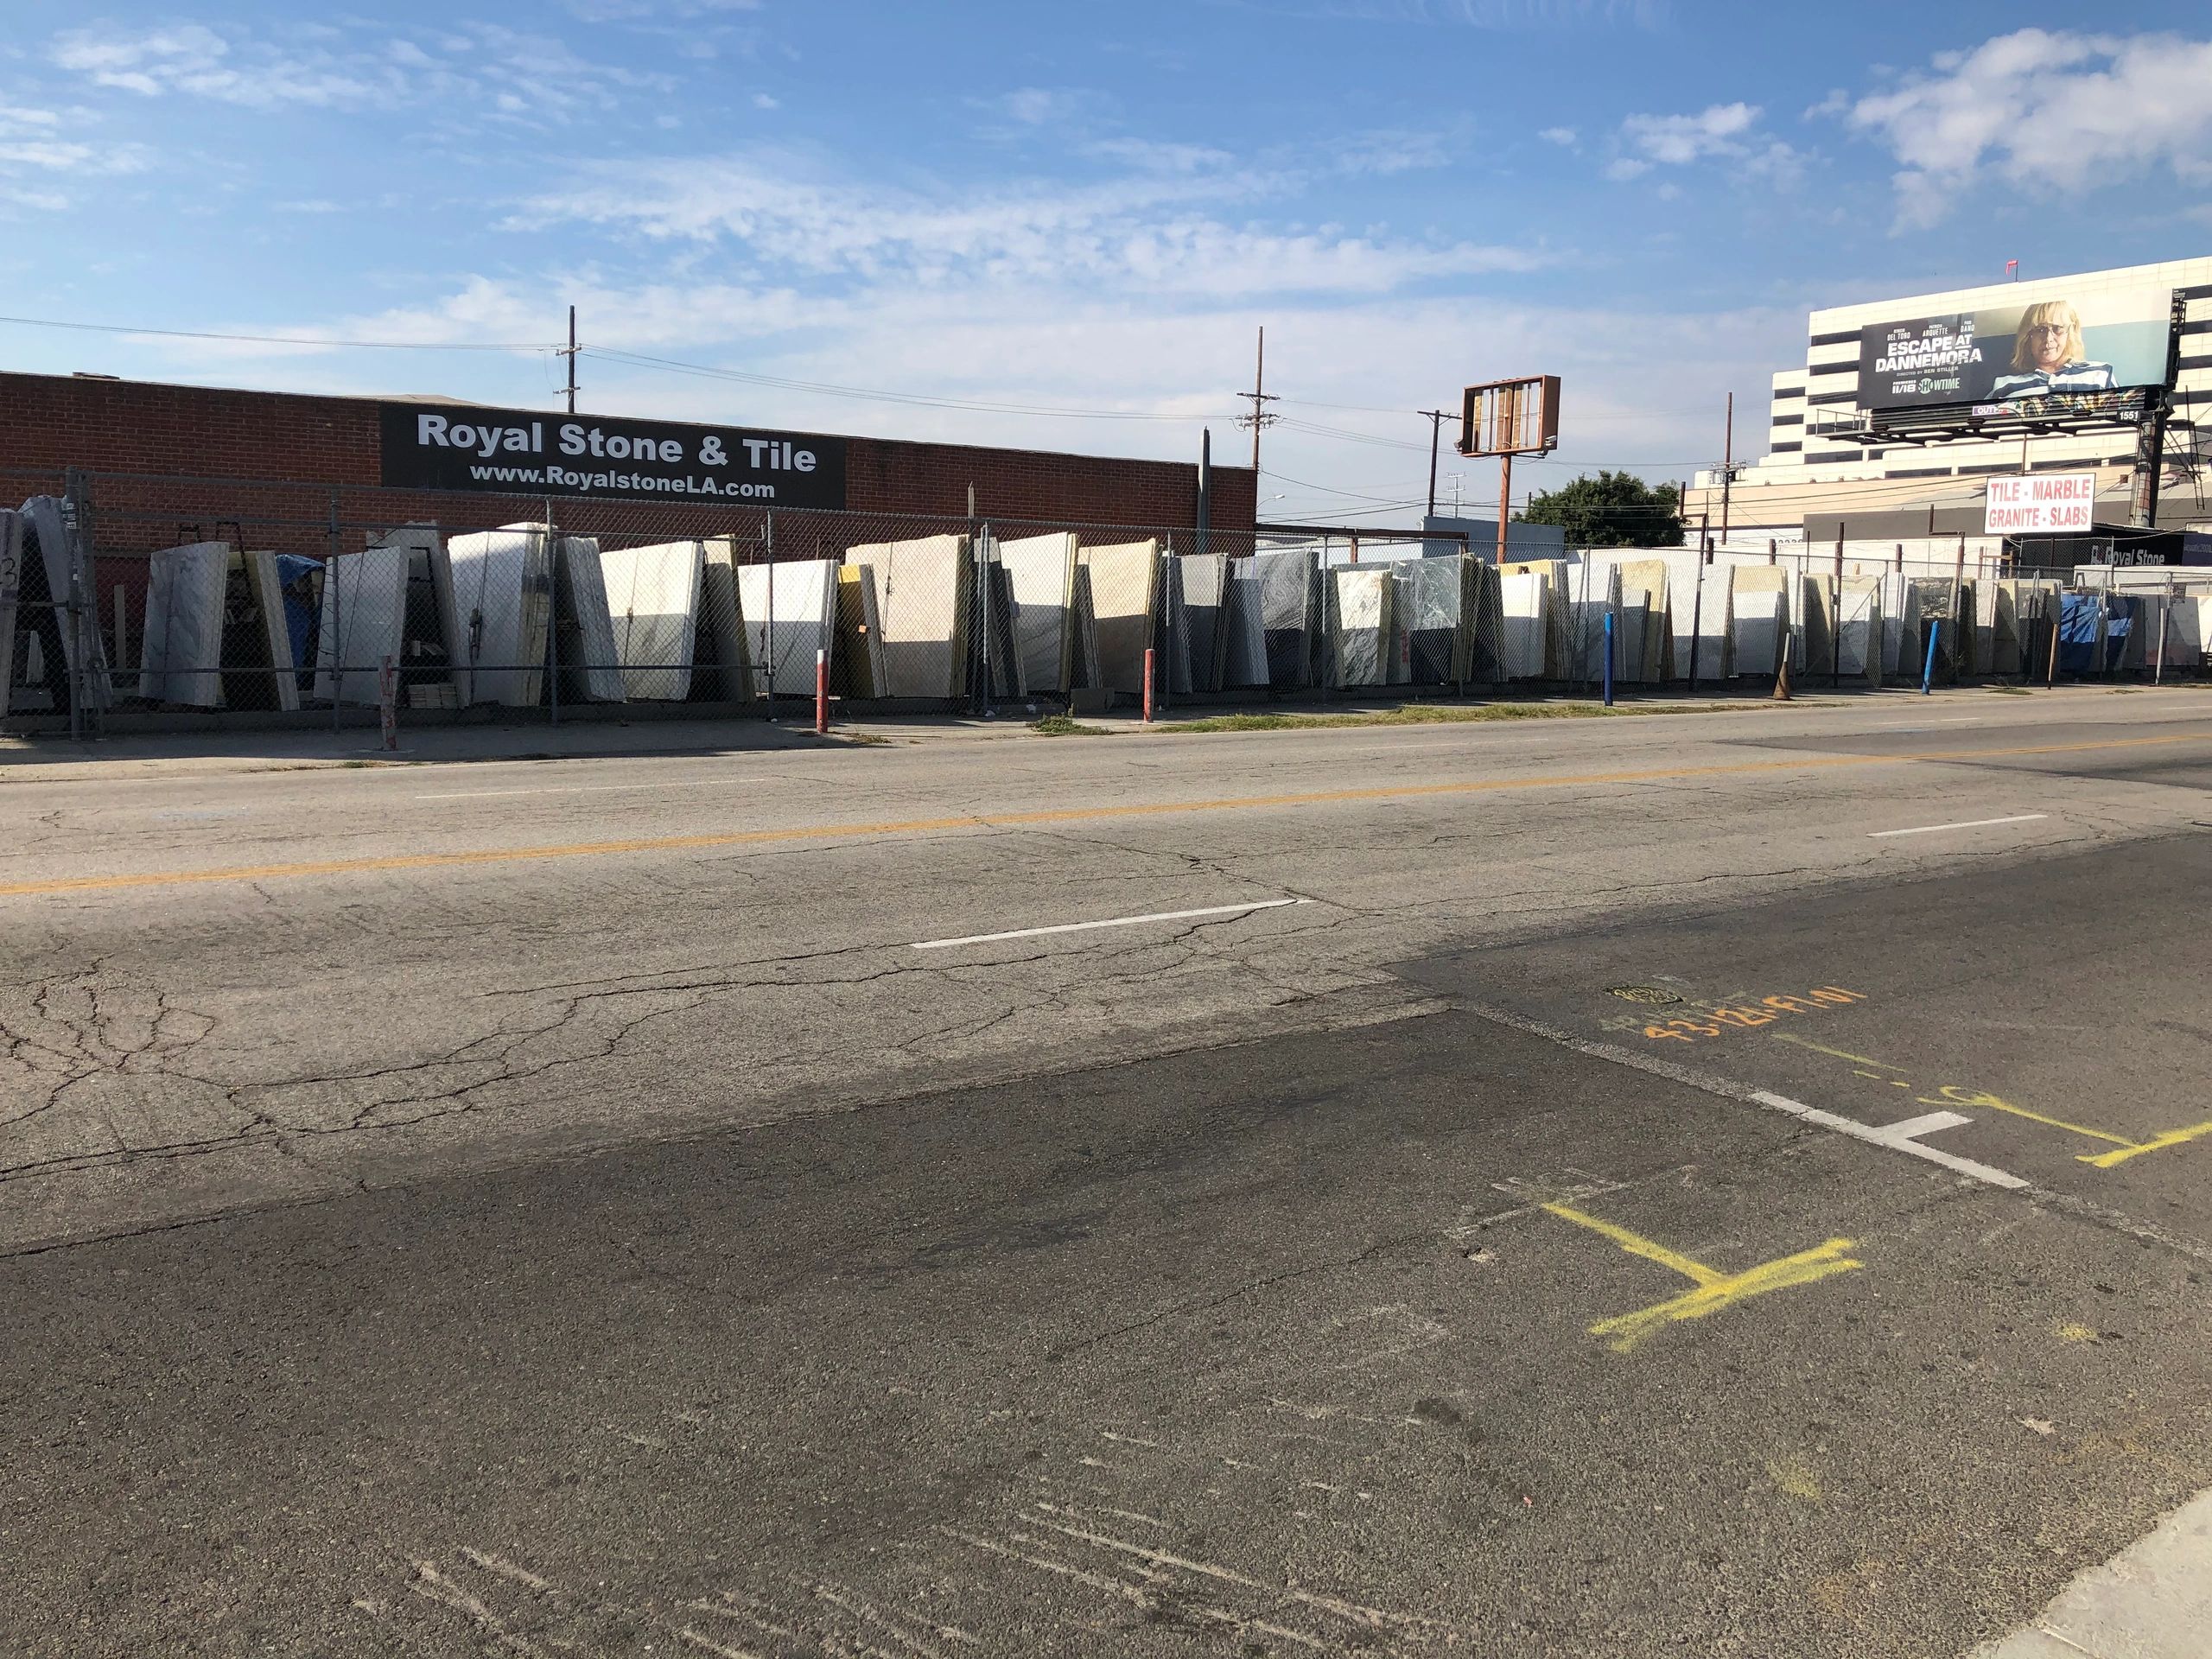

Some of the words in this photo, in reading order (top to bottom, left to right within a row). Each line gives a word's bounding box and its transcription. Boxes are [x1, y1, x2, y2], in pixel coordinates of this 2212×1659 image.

[1923, 327, 1948, 337] ARQUETTE
[1960, 324, 1975, 333] DANO
[1887, 336, 1953, 357] ESCAPE
[1955, 334, 1973, 347] AT
[1875, 348, 1982, 372] DANNEMORA
[1891, 385, 1916, 394] 11/18
[1918, 378, 1961, 394] SHOWTIME
[2120, 410, 2139, 421] 1551
[417, 414, 543, 458] Royal
[558, 423, 683, 463] Stone
[698, 435, 728, 466] &
[742, 438, 817, 473] Tile
[469, 465, 775, 499] www.RoyalstoneLA.com
[1991, 482, 2020, 502] TILE
[2032, 479, 2091, 500] MARBLE
[1988, 507, 2040, 528] GRANITE
[2050, 505, 2088, 526] SLABS
[2136, 549, 2165, 566] Stone
